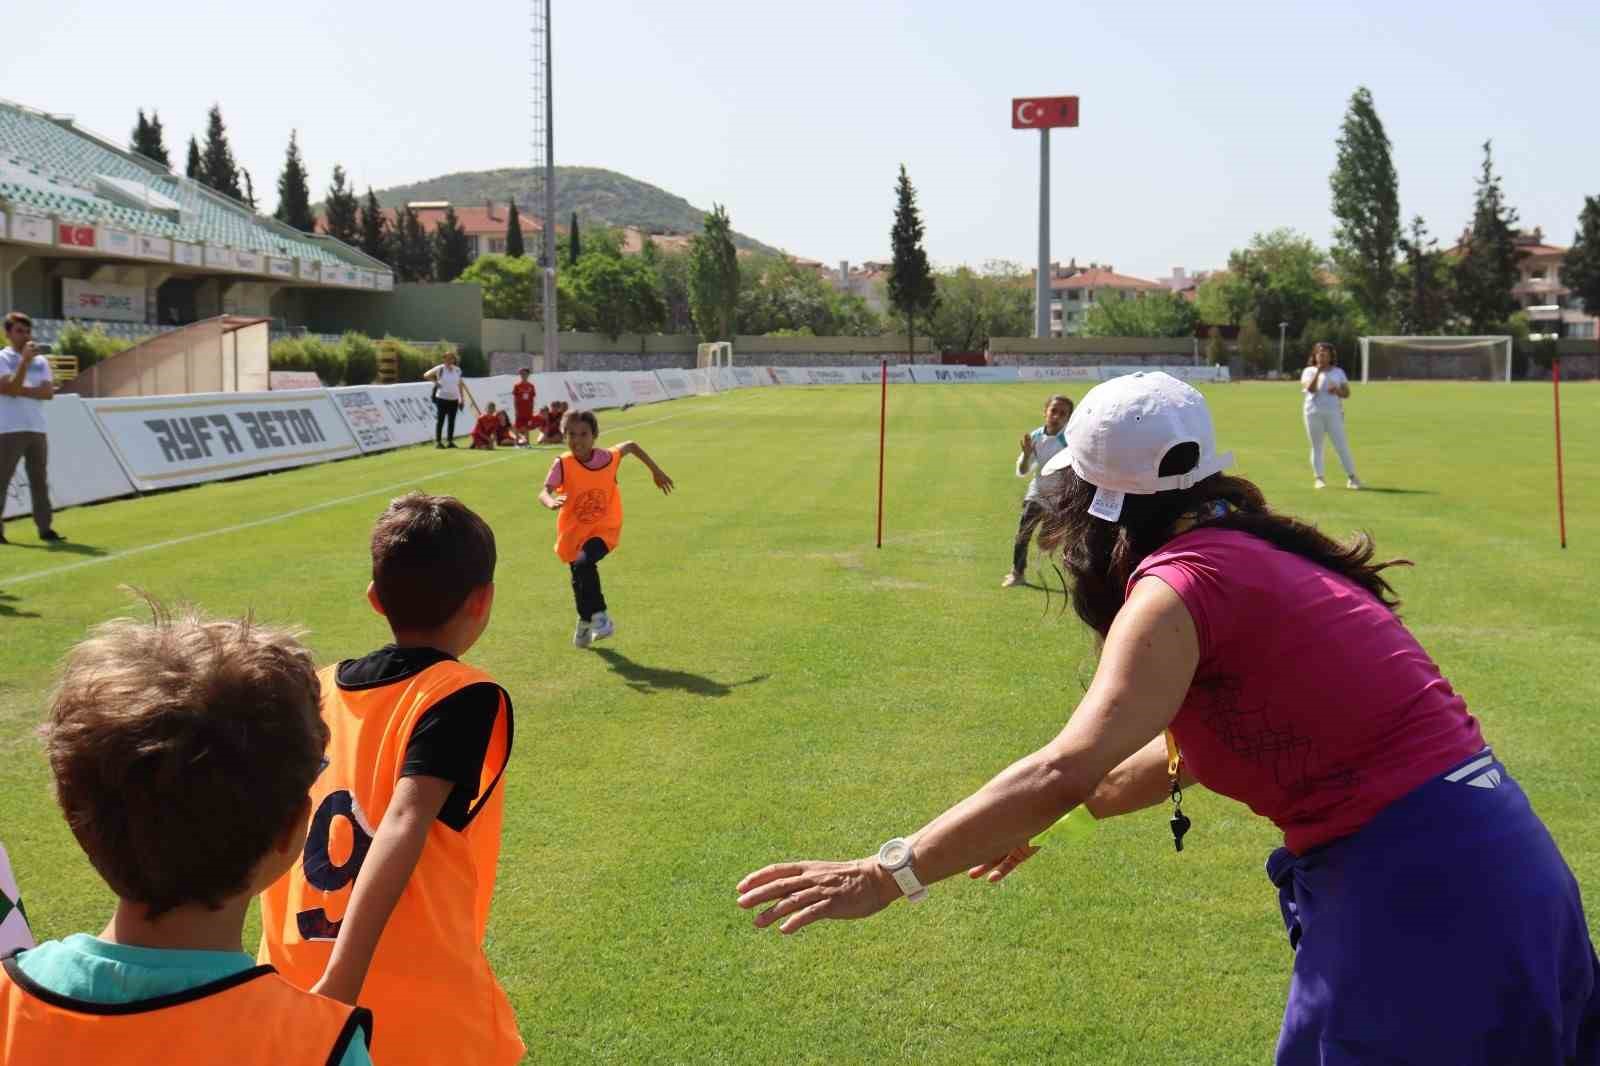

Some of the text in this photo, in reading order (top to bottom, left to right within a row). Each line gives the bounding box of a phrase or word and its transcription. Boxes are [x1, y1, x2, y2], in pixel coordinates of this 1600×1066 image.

[144, 413, 244, 463] AYFA
[235, 408, 327, 450] BETON
[296, 789, 375, 941] 9
